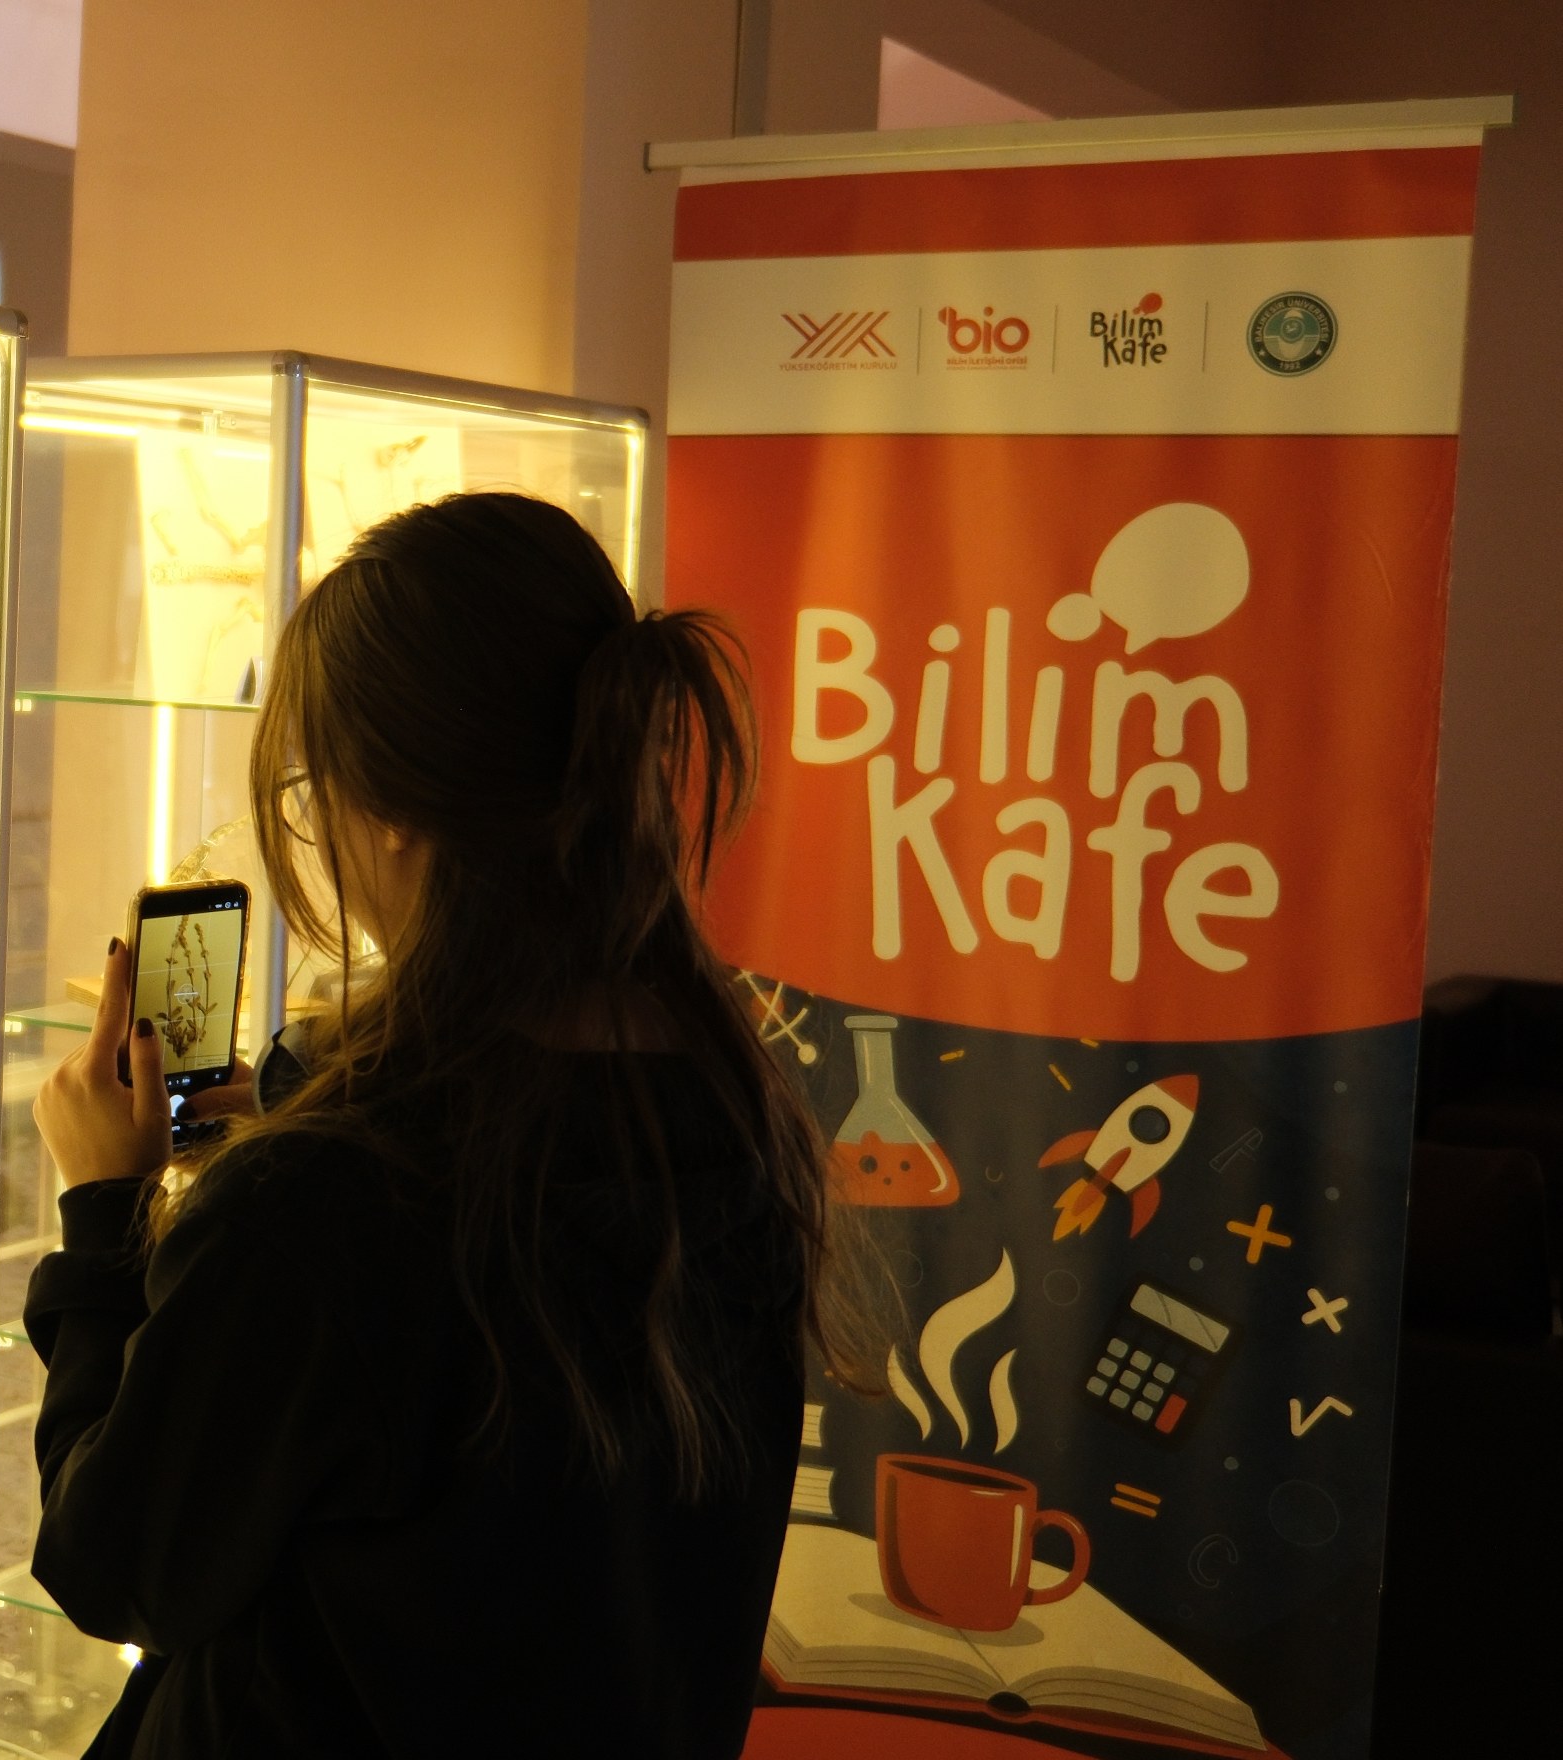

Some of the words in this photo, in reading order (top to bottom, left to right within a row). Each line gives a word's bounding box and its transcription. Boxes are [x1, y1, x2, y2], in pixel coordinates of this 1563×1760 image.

[938, 306, 1030, 354] bio
[1090, 309, 1163, 338] Bilim
[1102, 332, 1167, 367] Kafe
[791, 605, 1248, 799] Bilim
[867, 754, 1280, 983] Kafe
